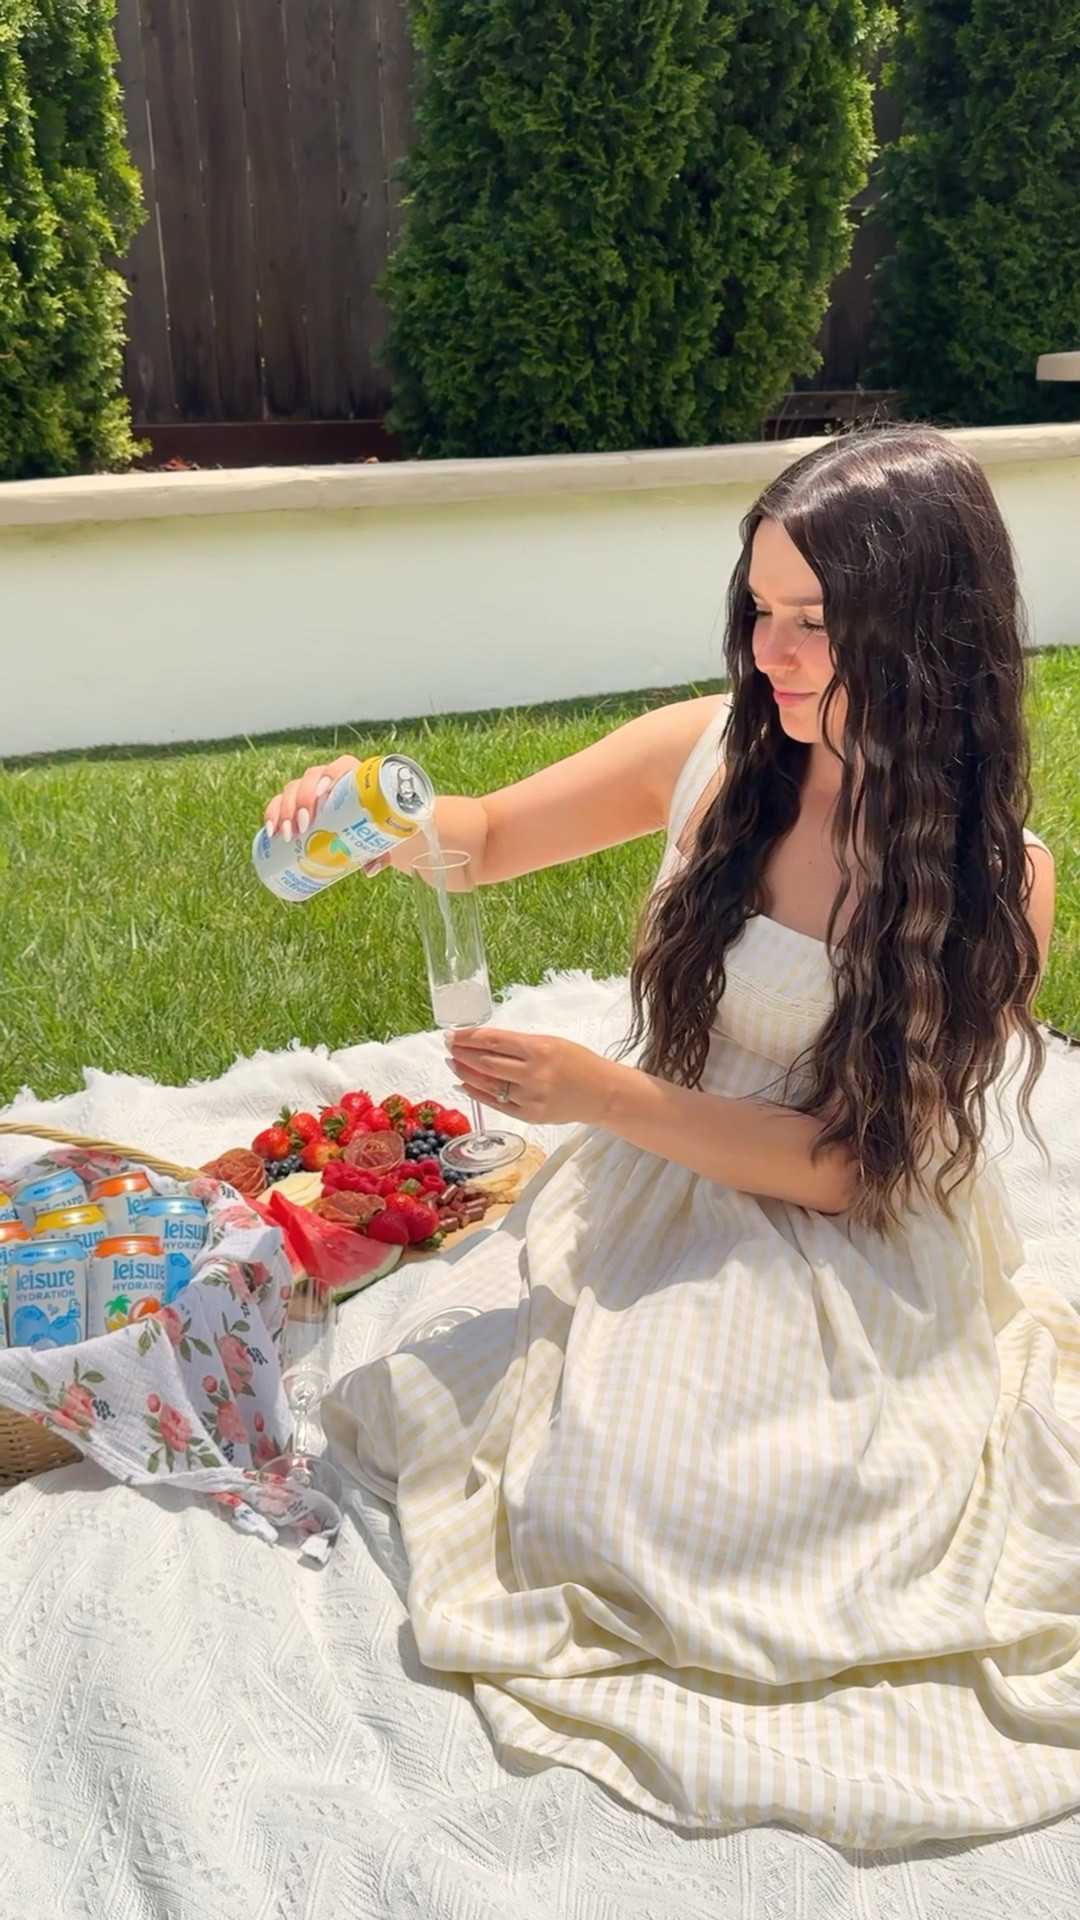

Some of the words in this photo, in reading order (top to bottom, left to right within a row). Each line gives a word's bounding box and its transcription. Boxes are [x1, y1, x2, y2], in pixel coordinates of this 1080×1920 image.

[16, 1270, 75, 1291] leisure
[112, 1281, 165, 1292] HYDRATIO
[16, 1289, 76, 1302] HYDRATION
